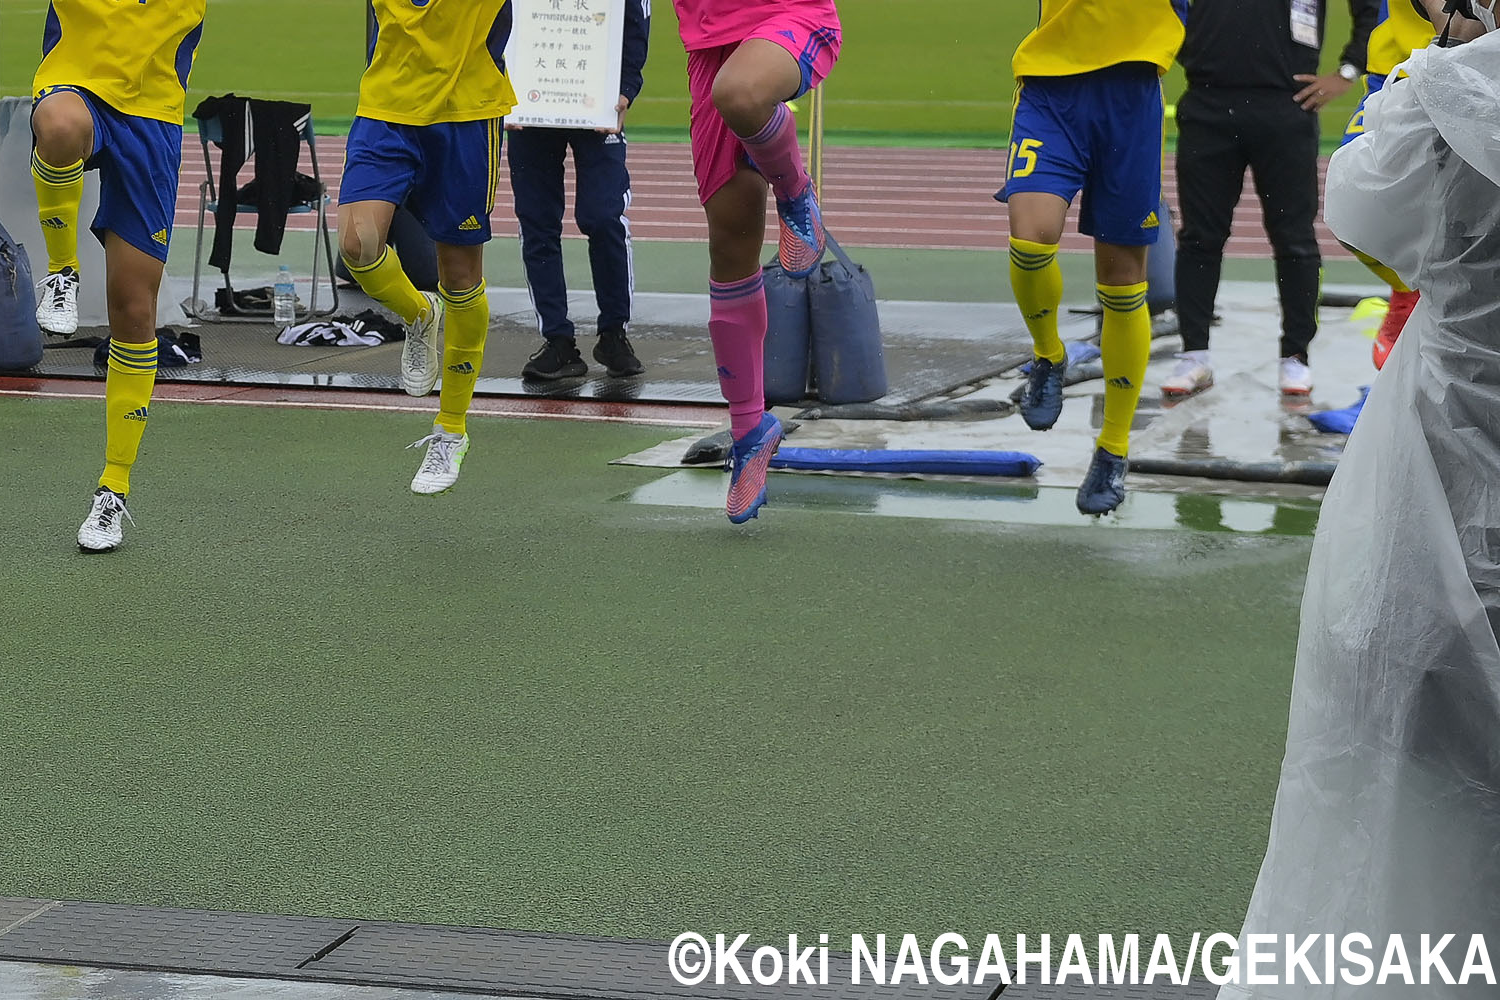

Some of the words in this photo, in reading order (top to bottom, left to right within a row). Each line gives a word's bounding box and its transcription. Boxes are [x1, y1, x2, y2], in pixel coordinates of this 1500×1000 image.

[534, 56, 588, 71] 大阪府
[1008, 138, 1044, 181] 15
